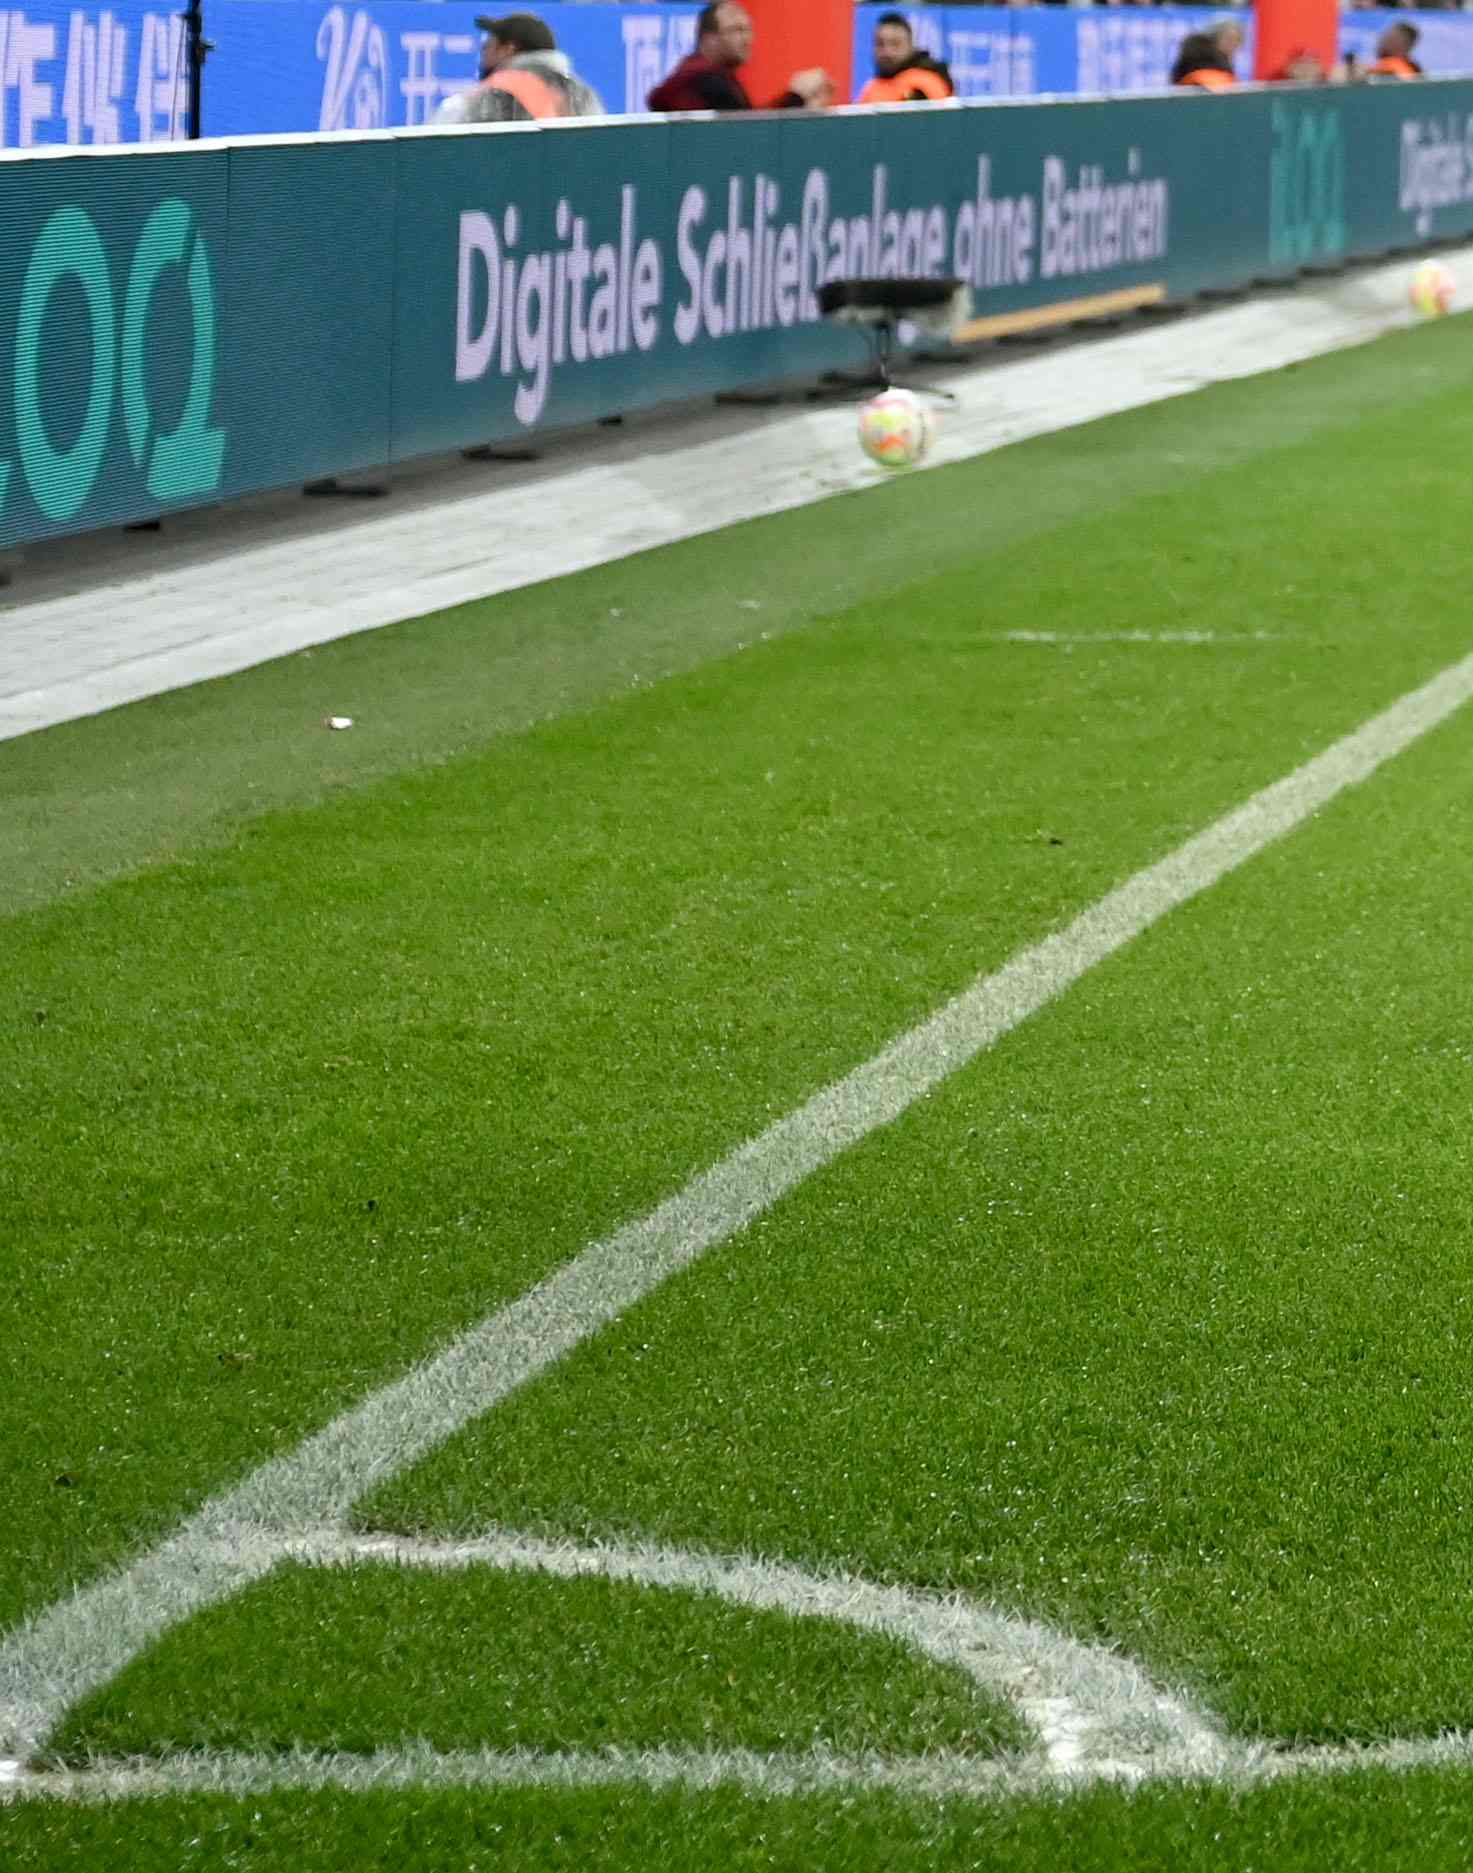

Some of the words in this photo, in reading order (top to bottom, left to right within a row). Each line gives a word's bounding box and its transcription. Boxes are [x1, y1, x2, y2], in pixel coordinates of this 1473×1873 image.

[0, 196, 226, 522] OQ
[455, 184, 663, 427] Digitale
[953, 153, 1035, 286] ohne
[1041, 147, 1168, 279] Batterien
